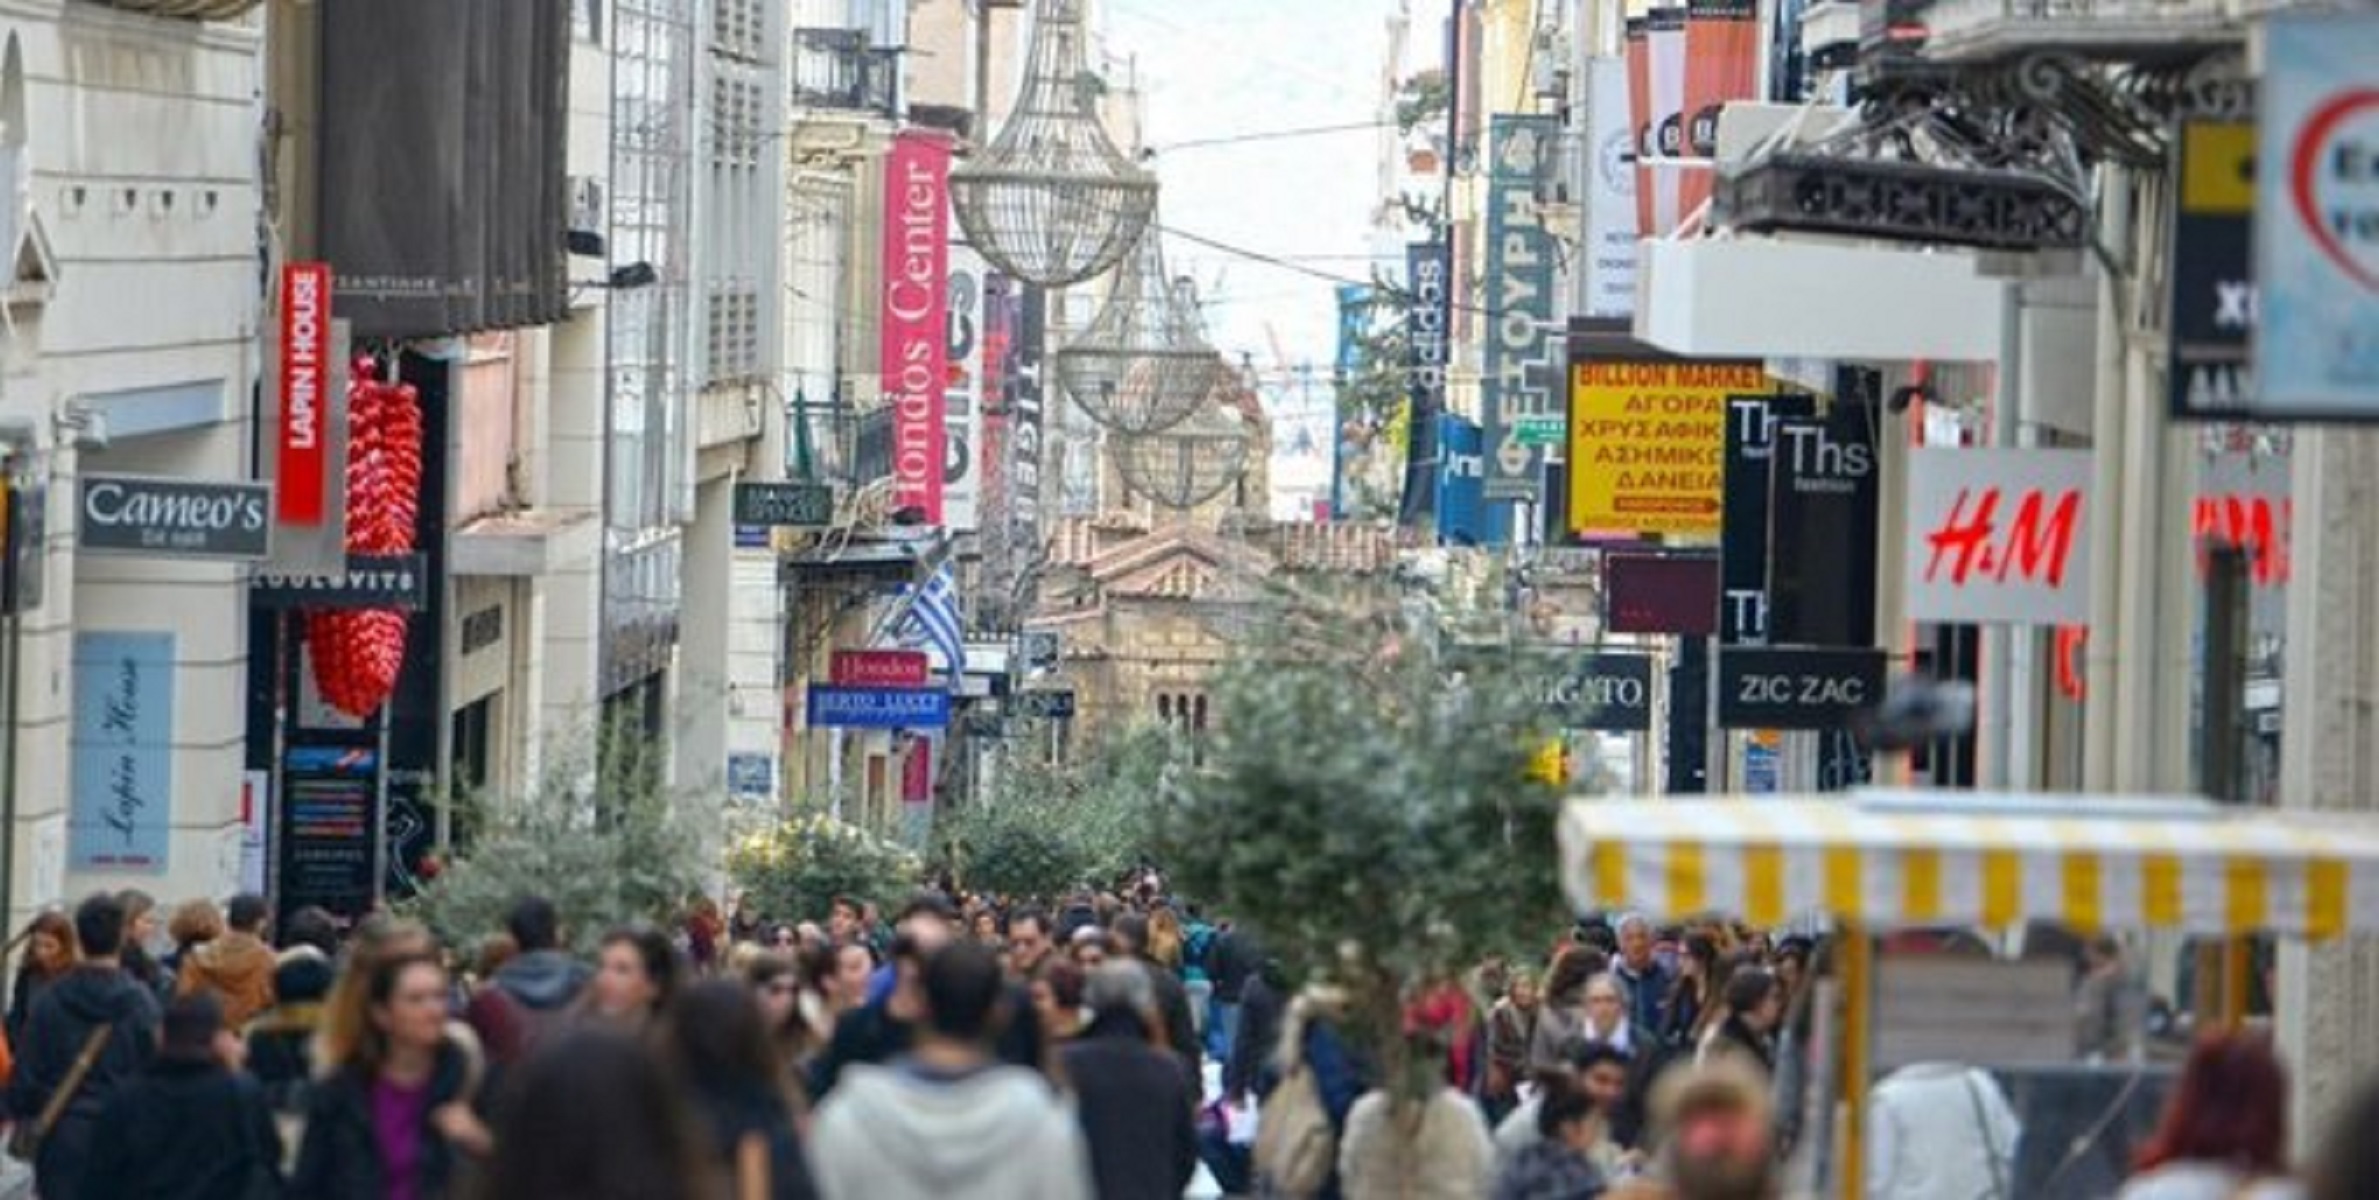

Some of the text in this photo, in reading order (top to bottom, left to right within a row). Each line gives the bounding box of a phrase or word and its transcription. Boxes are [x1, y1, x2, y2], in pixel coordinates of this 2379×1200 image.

[889, 161, 935, 321] Center
[1411, 258, 1443, 391] adidas
[288, 271, 318, 449] LAPIN HOUSE
[1580, 363, 1764, 387] BILLION MARKET
[1625, 395, 1721, 414] ΑΓΟΡΑ
[1731, 400, 1777, 443] Th
[1580, 419, 1721, 437] ΧΡΥΣΑΦΙΚ
[1595, 447, 1721, 464] ΑΣΗΜΙΚ
[1781, 425, 1870, 478] Ths
[86, 483, 263, 532] Cameo's
[1923, 486, 2082, 588] H&M
[1739, 673, 1864, 704] ZIC ZAC
